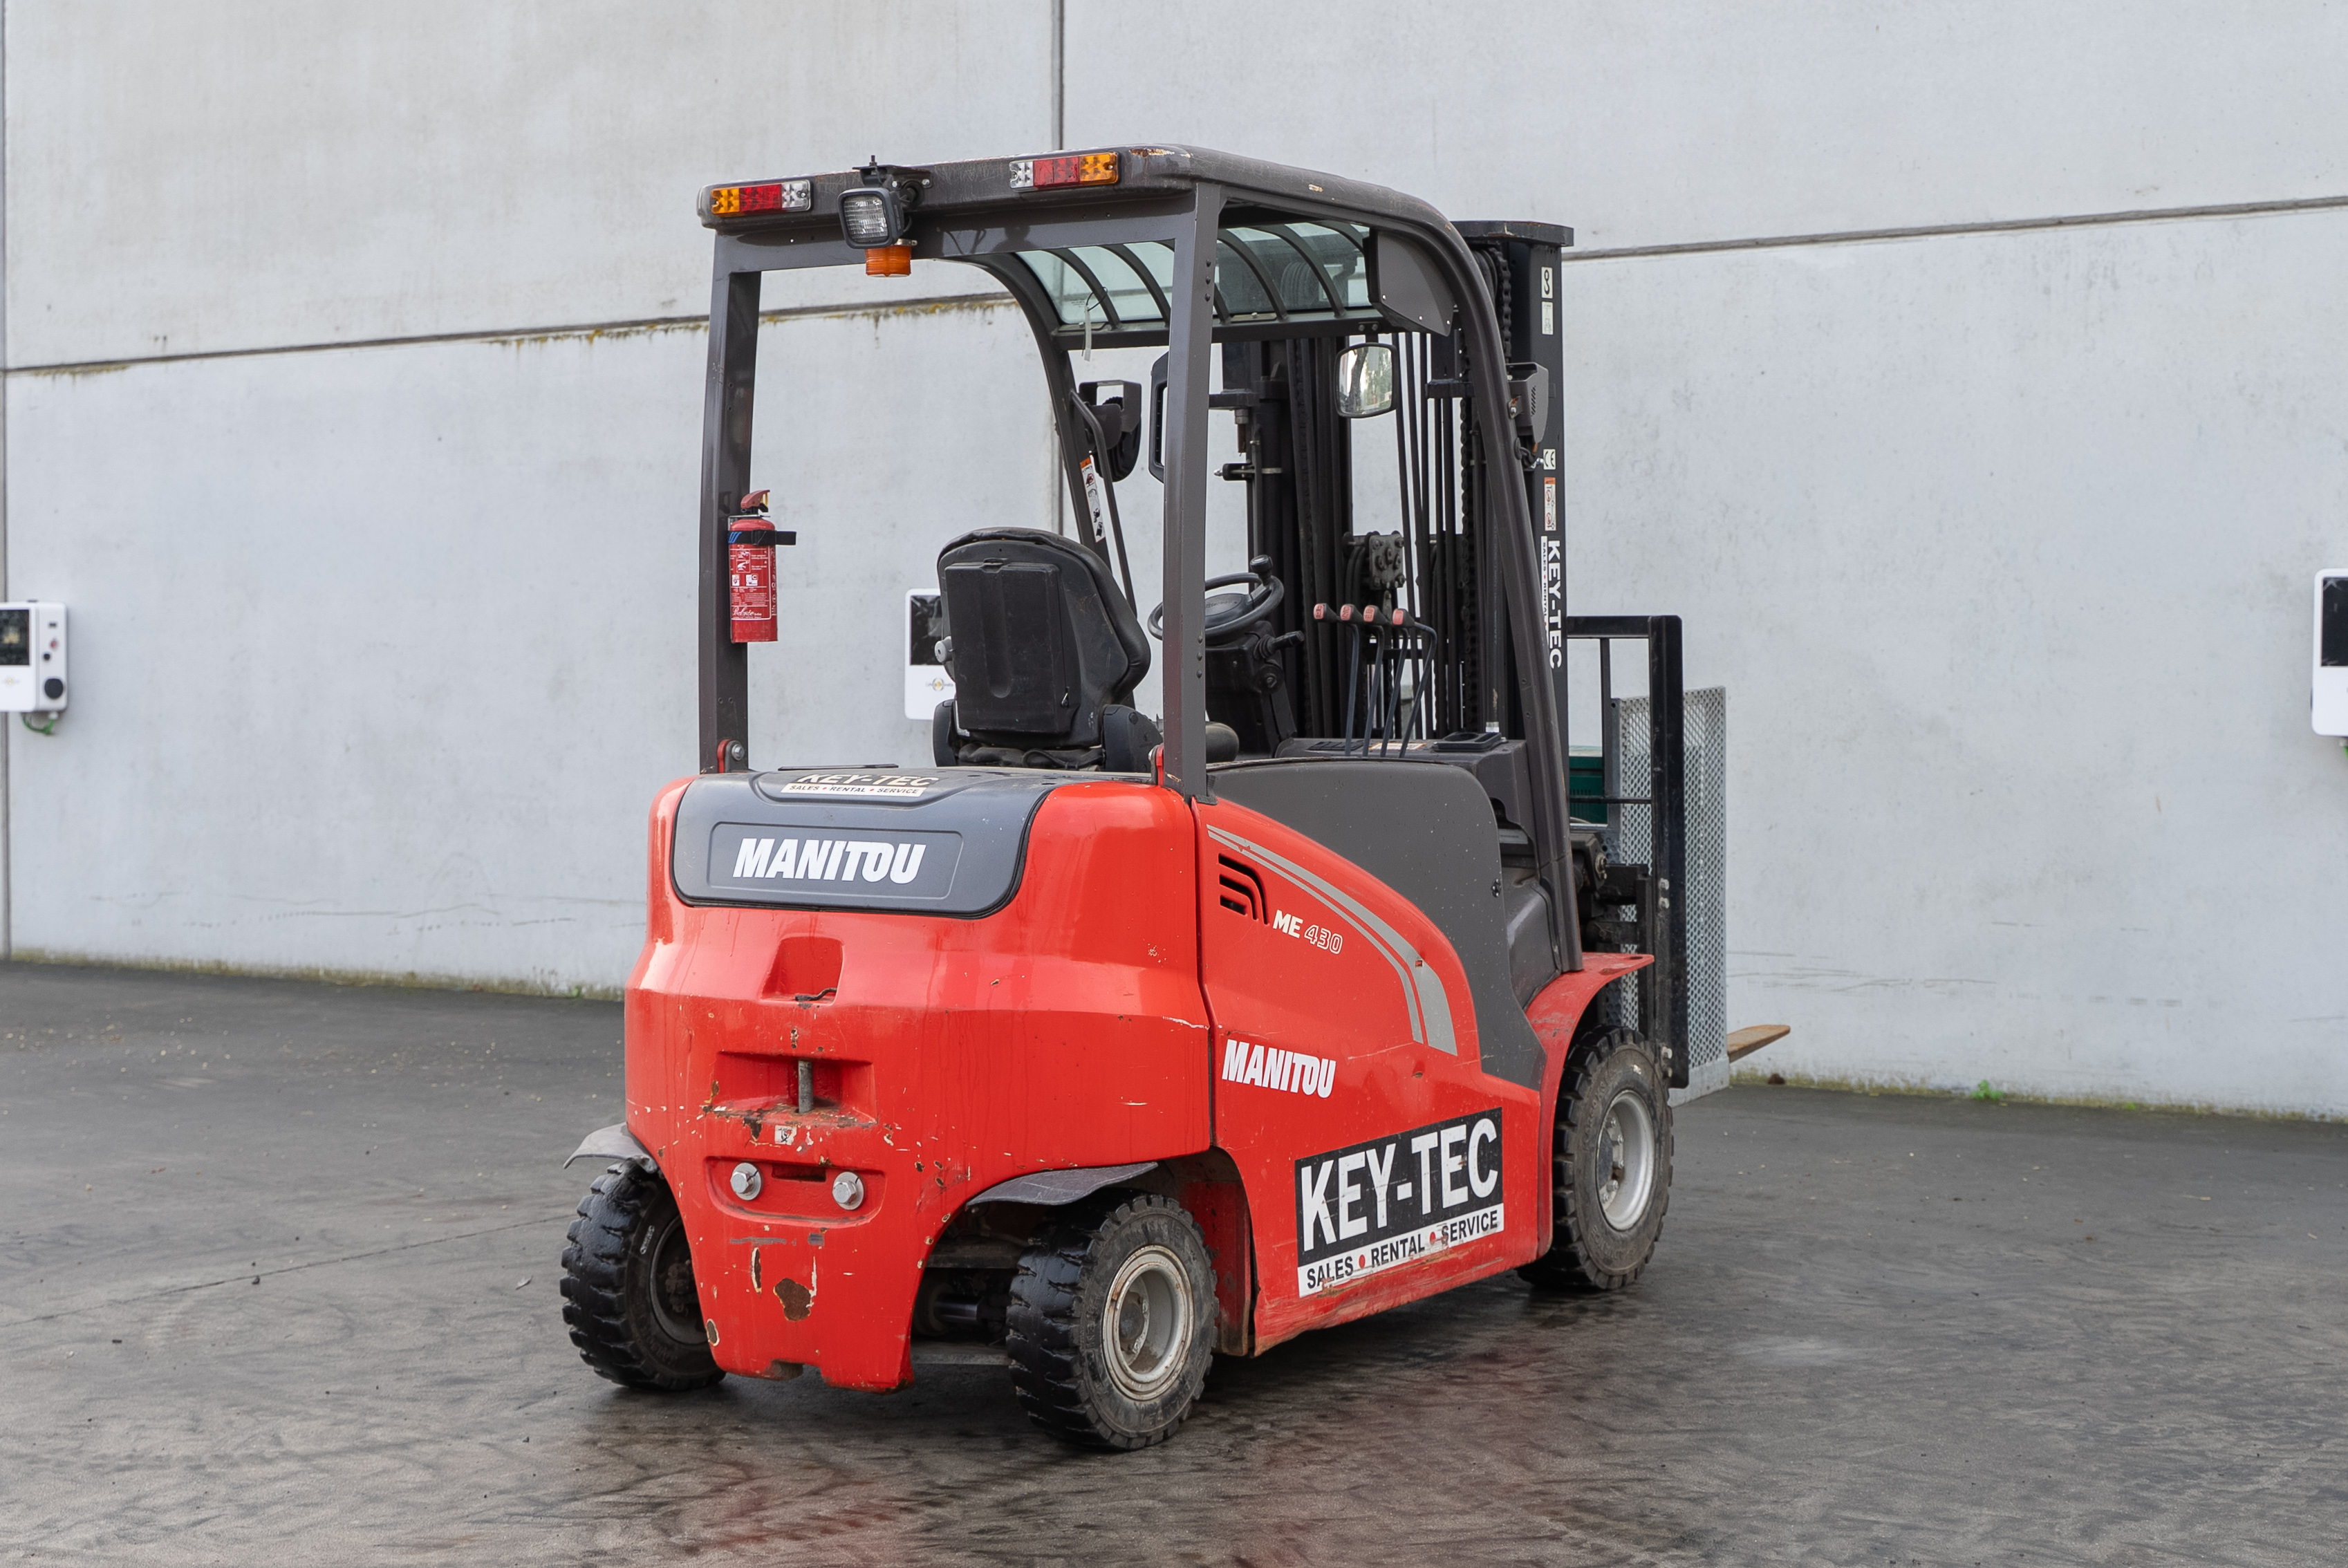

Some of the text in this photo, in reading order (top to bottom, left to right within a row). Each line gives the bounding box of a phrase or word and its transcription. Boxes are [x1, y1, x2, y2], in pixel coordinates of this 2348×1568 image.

[1548, 541, 1562, 669] KEY-TEC
[797, 774, 939, 787] KEY-TEC
[733, 838, 926, 884] MANITOU
[1272, 909, 1343, 955] ME 430
[1222, 1038, 1336, 1099] MANITOU
[1301, 1119, 1498, 1252] KEY-TEC
[1307, 1209, 1498, 1290] SALES RENTAL SERVICE
